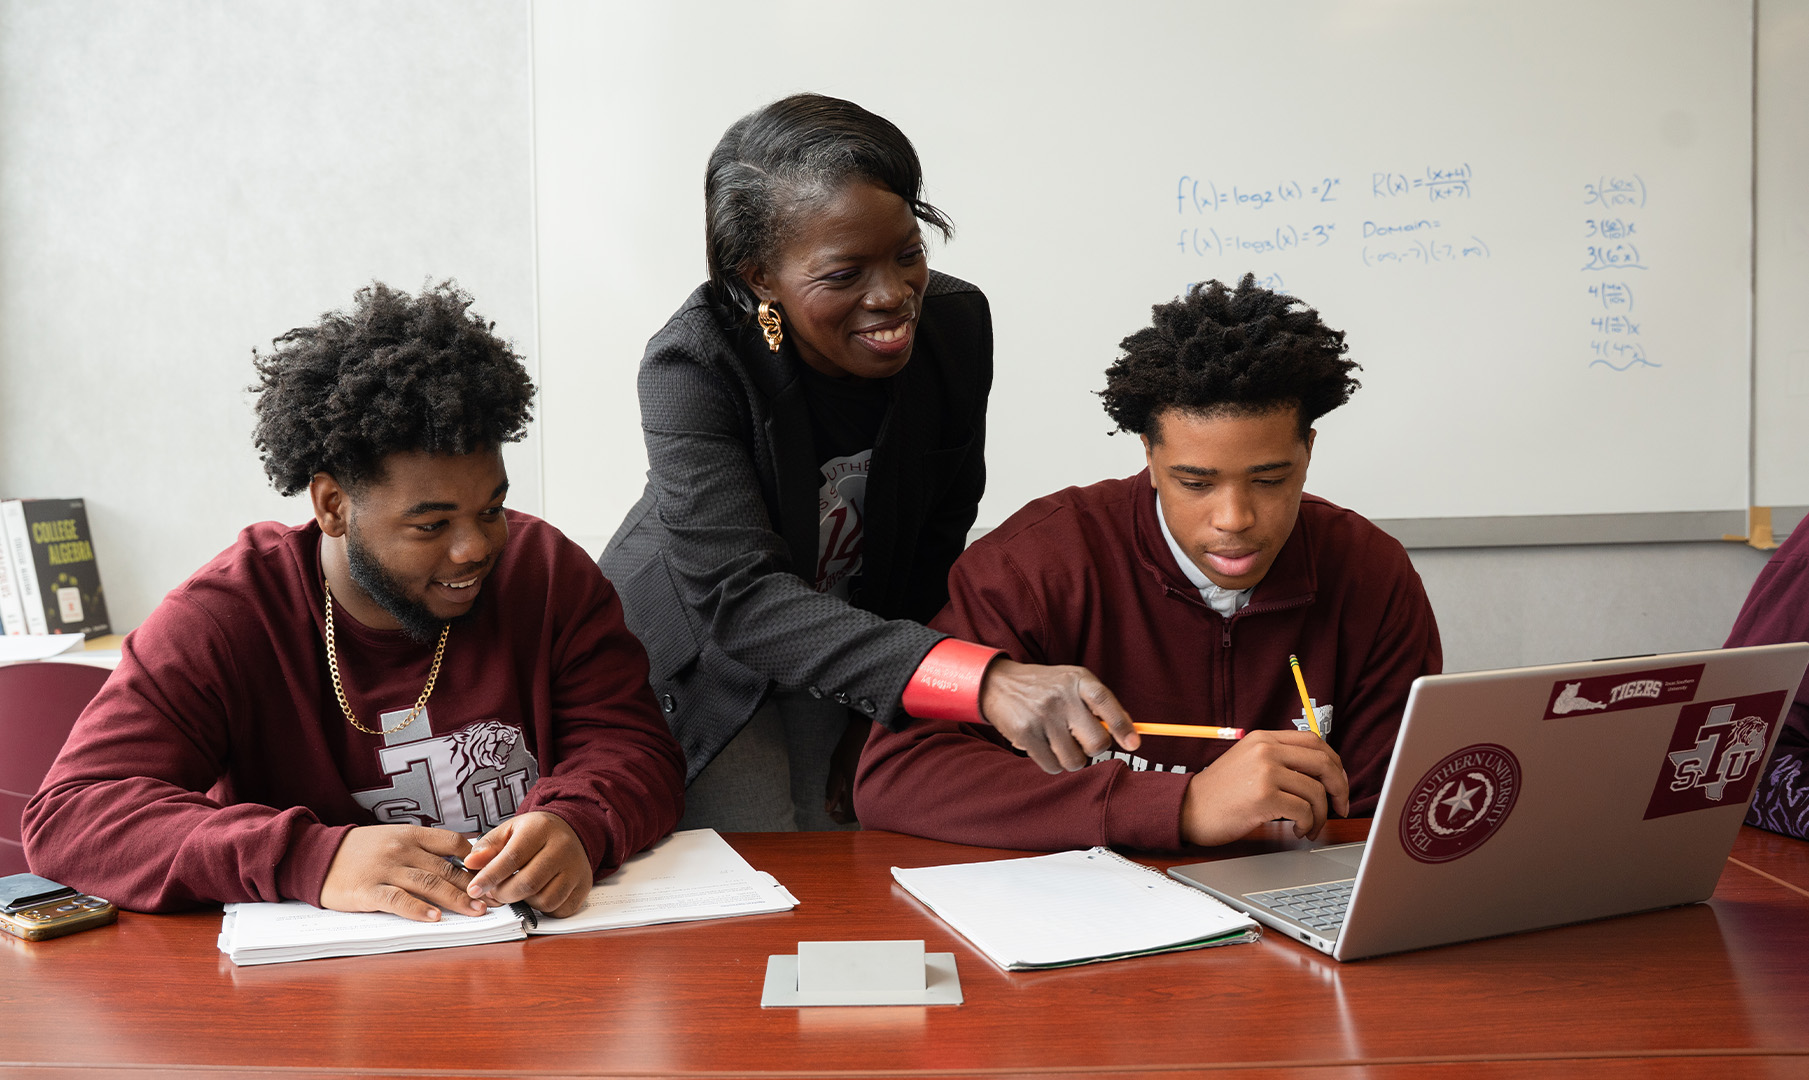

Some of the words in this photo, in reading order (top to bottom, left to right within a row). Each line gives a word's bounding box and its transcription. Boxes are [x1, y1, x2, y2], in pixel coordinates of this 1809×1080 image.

[32, 519, 79, 544] COLLEGE
[48, 540, 94, 565] ALGEBRA
[1608, 679, 1663, 704] TIGERS
[1412, 753, 1485, 813] SOUTHERN
[1484, 753, 1512, 837] UNIVERSITY
[1409, 815, 1432, 852] TEXAS
